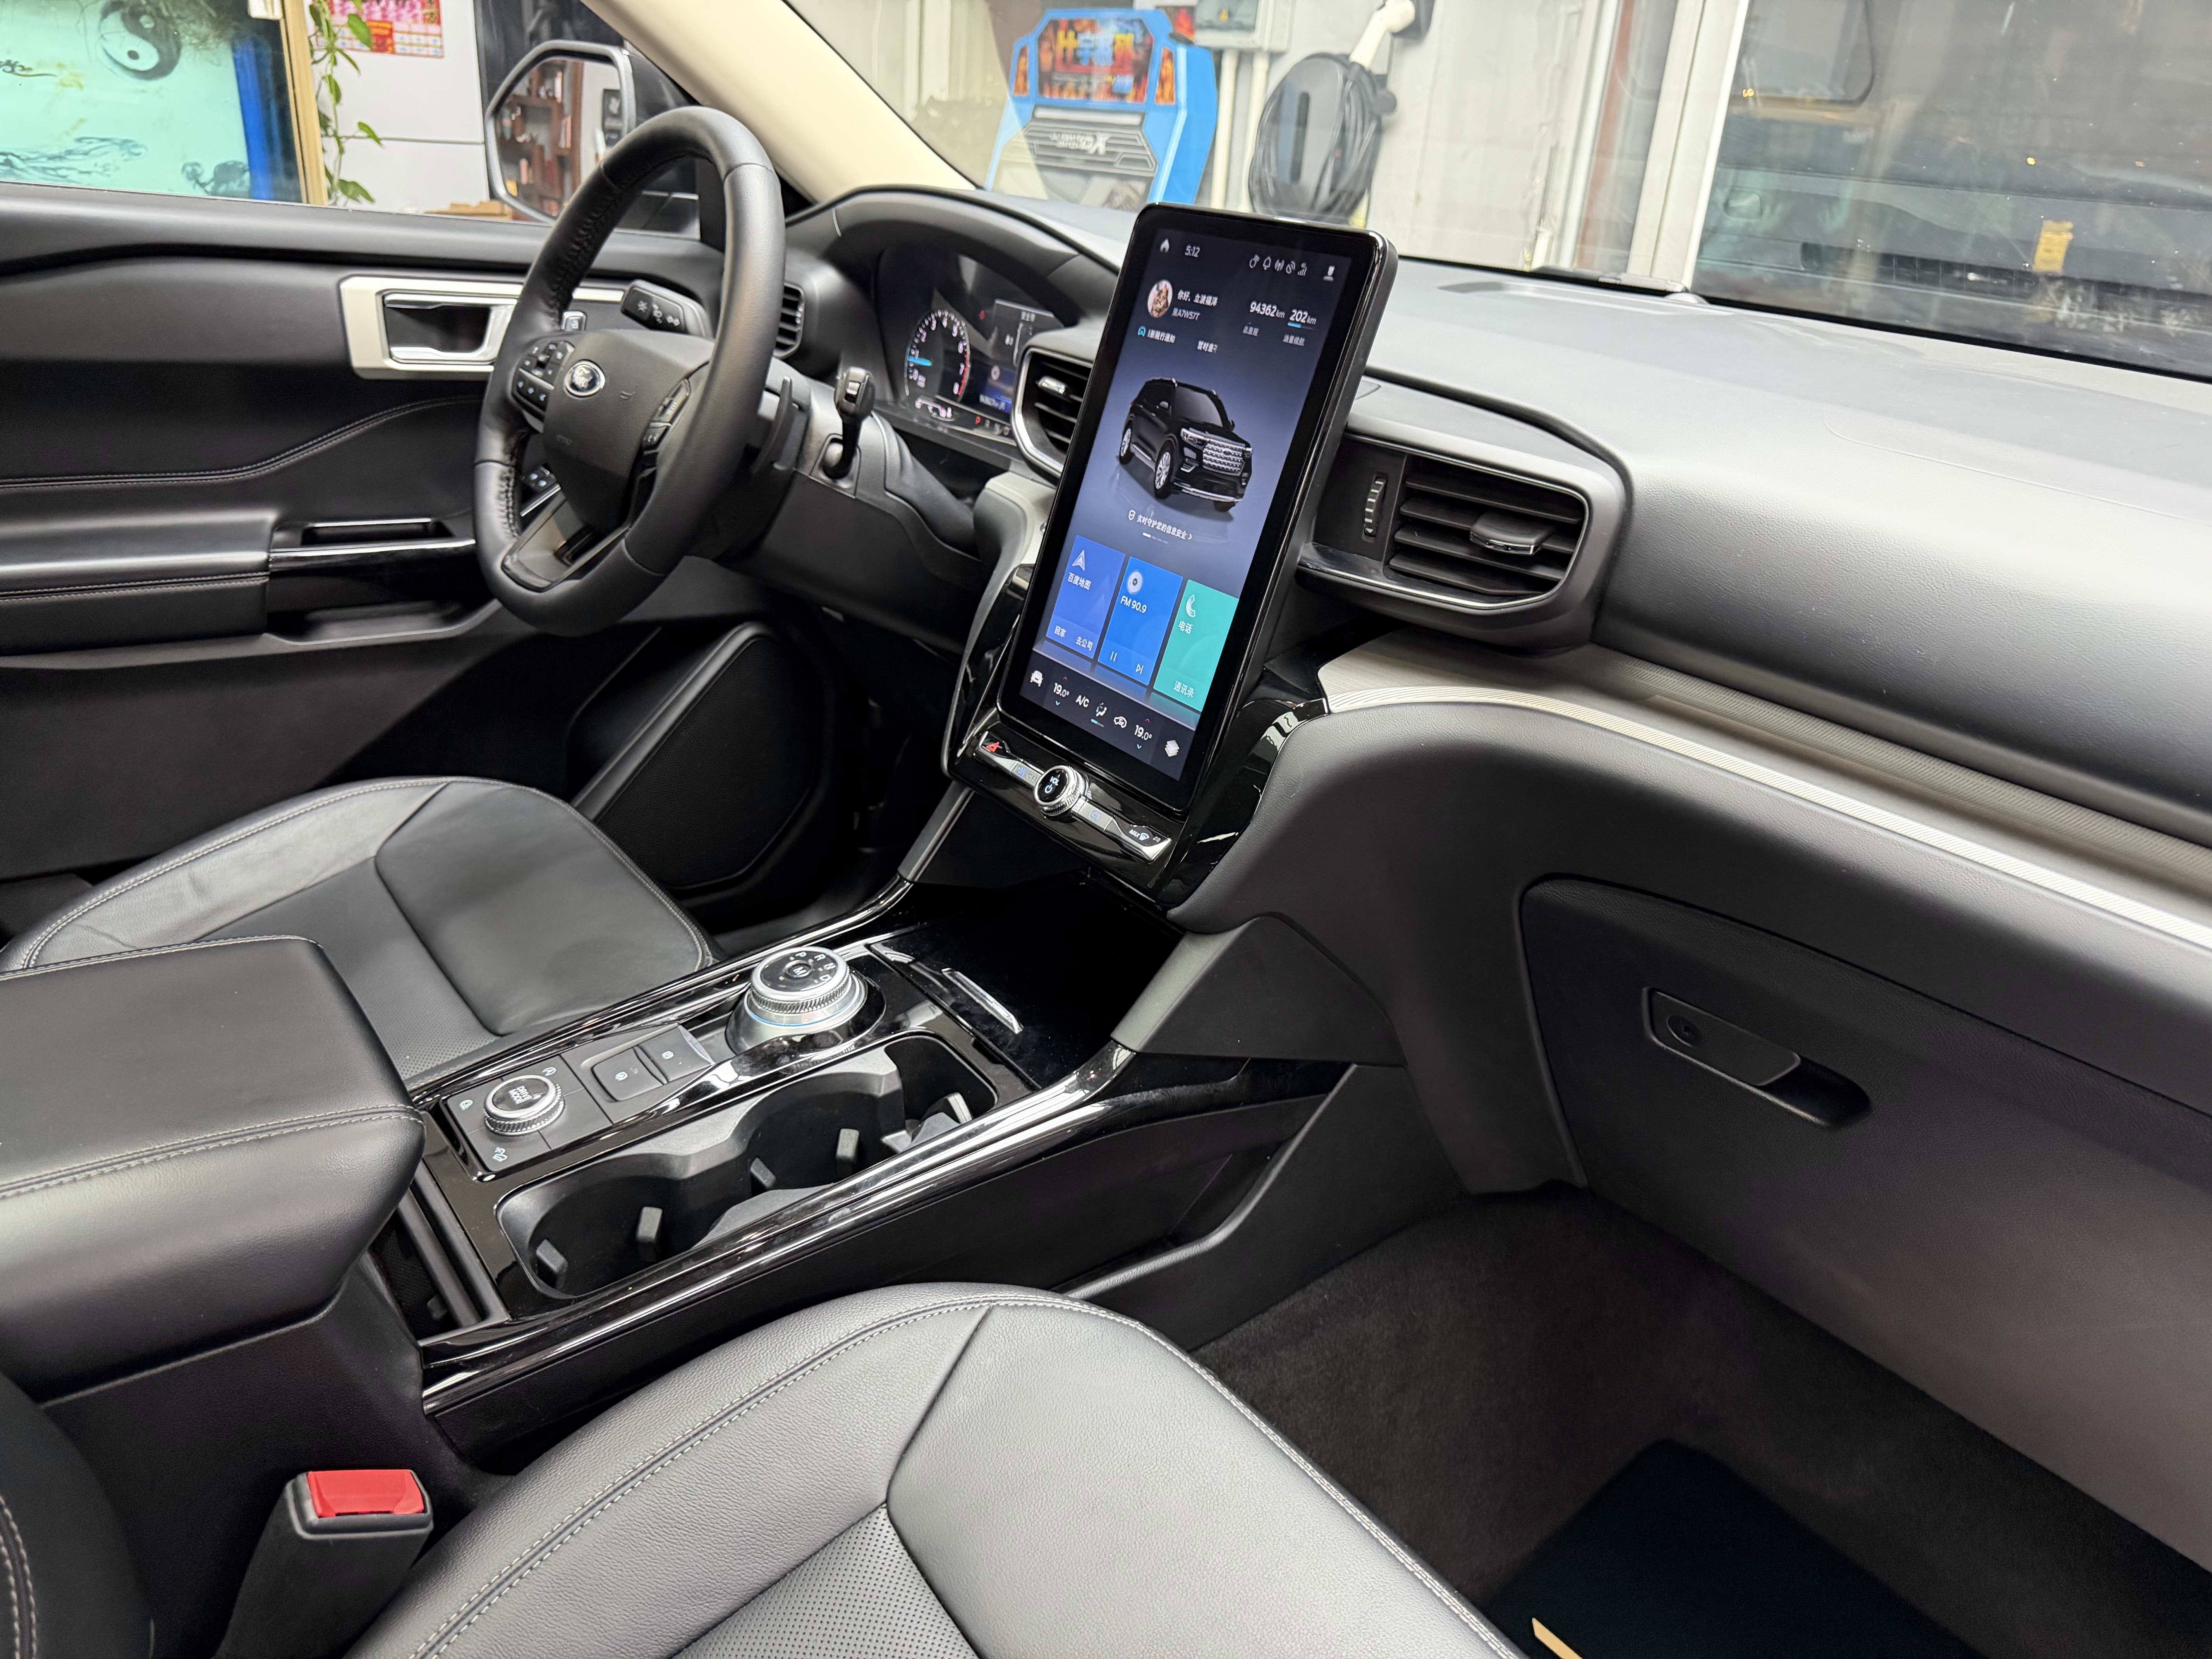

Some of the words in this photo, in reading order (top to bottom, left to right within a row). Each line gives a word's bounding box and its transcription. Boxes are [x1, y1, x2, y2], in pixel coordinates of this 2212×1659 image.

[1185, 245, 1200, 258] 5:12
[1137, 514, 1187, 539] 实时守护您的信息安全
[1067, 573, 1091, 590] 百度地图
[1120, 595, 1130, 607] FM
[1132, 601, 1147, 613] 90.9
[1054, 625, 1066, 638] 回家
[1178, 621, 1193, 634] 电话
[1076, 636, 1093, 651] 去公司
[1053, 683, 1070, 697] 19.0°
[1173, 681, 1194, 697] 通讯录
[1075, 695, 1089, 707] A/C
[1134, 725, 1152, 740] 19.0°
[1049, 776, 1060, 786] VOL
[1129, 829, 1140, 838] MAX
[793, 966, 807, 975] M
[508, 1089, 524, 1105] MODE
[517, 1085, 532, 1101] DRIVE
